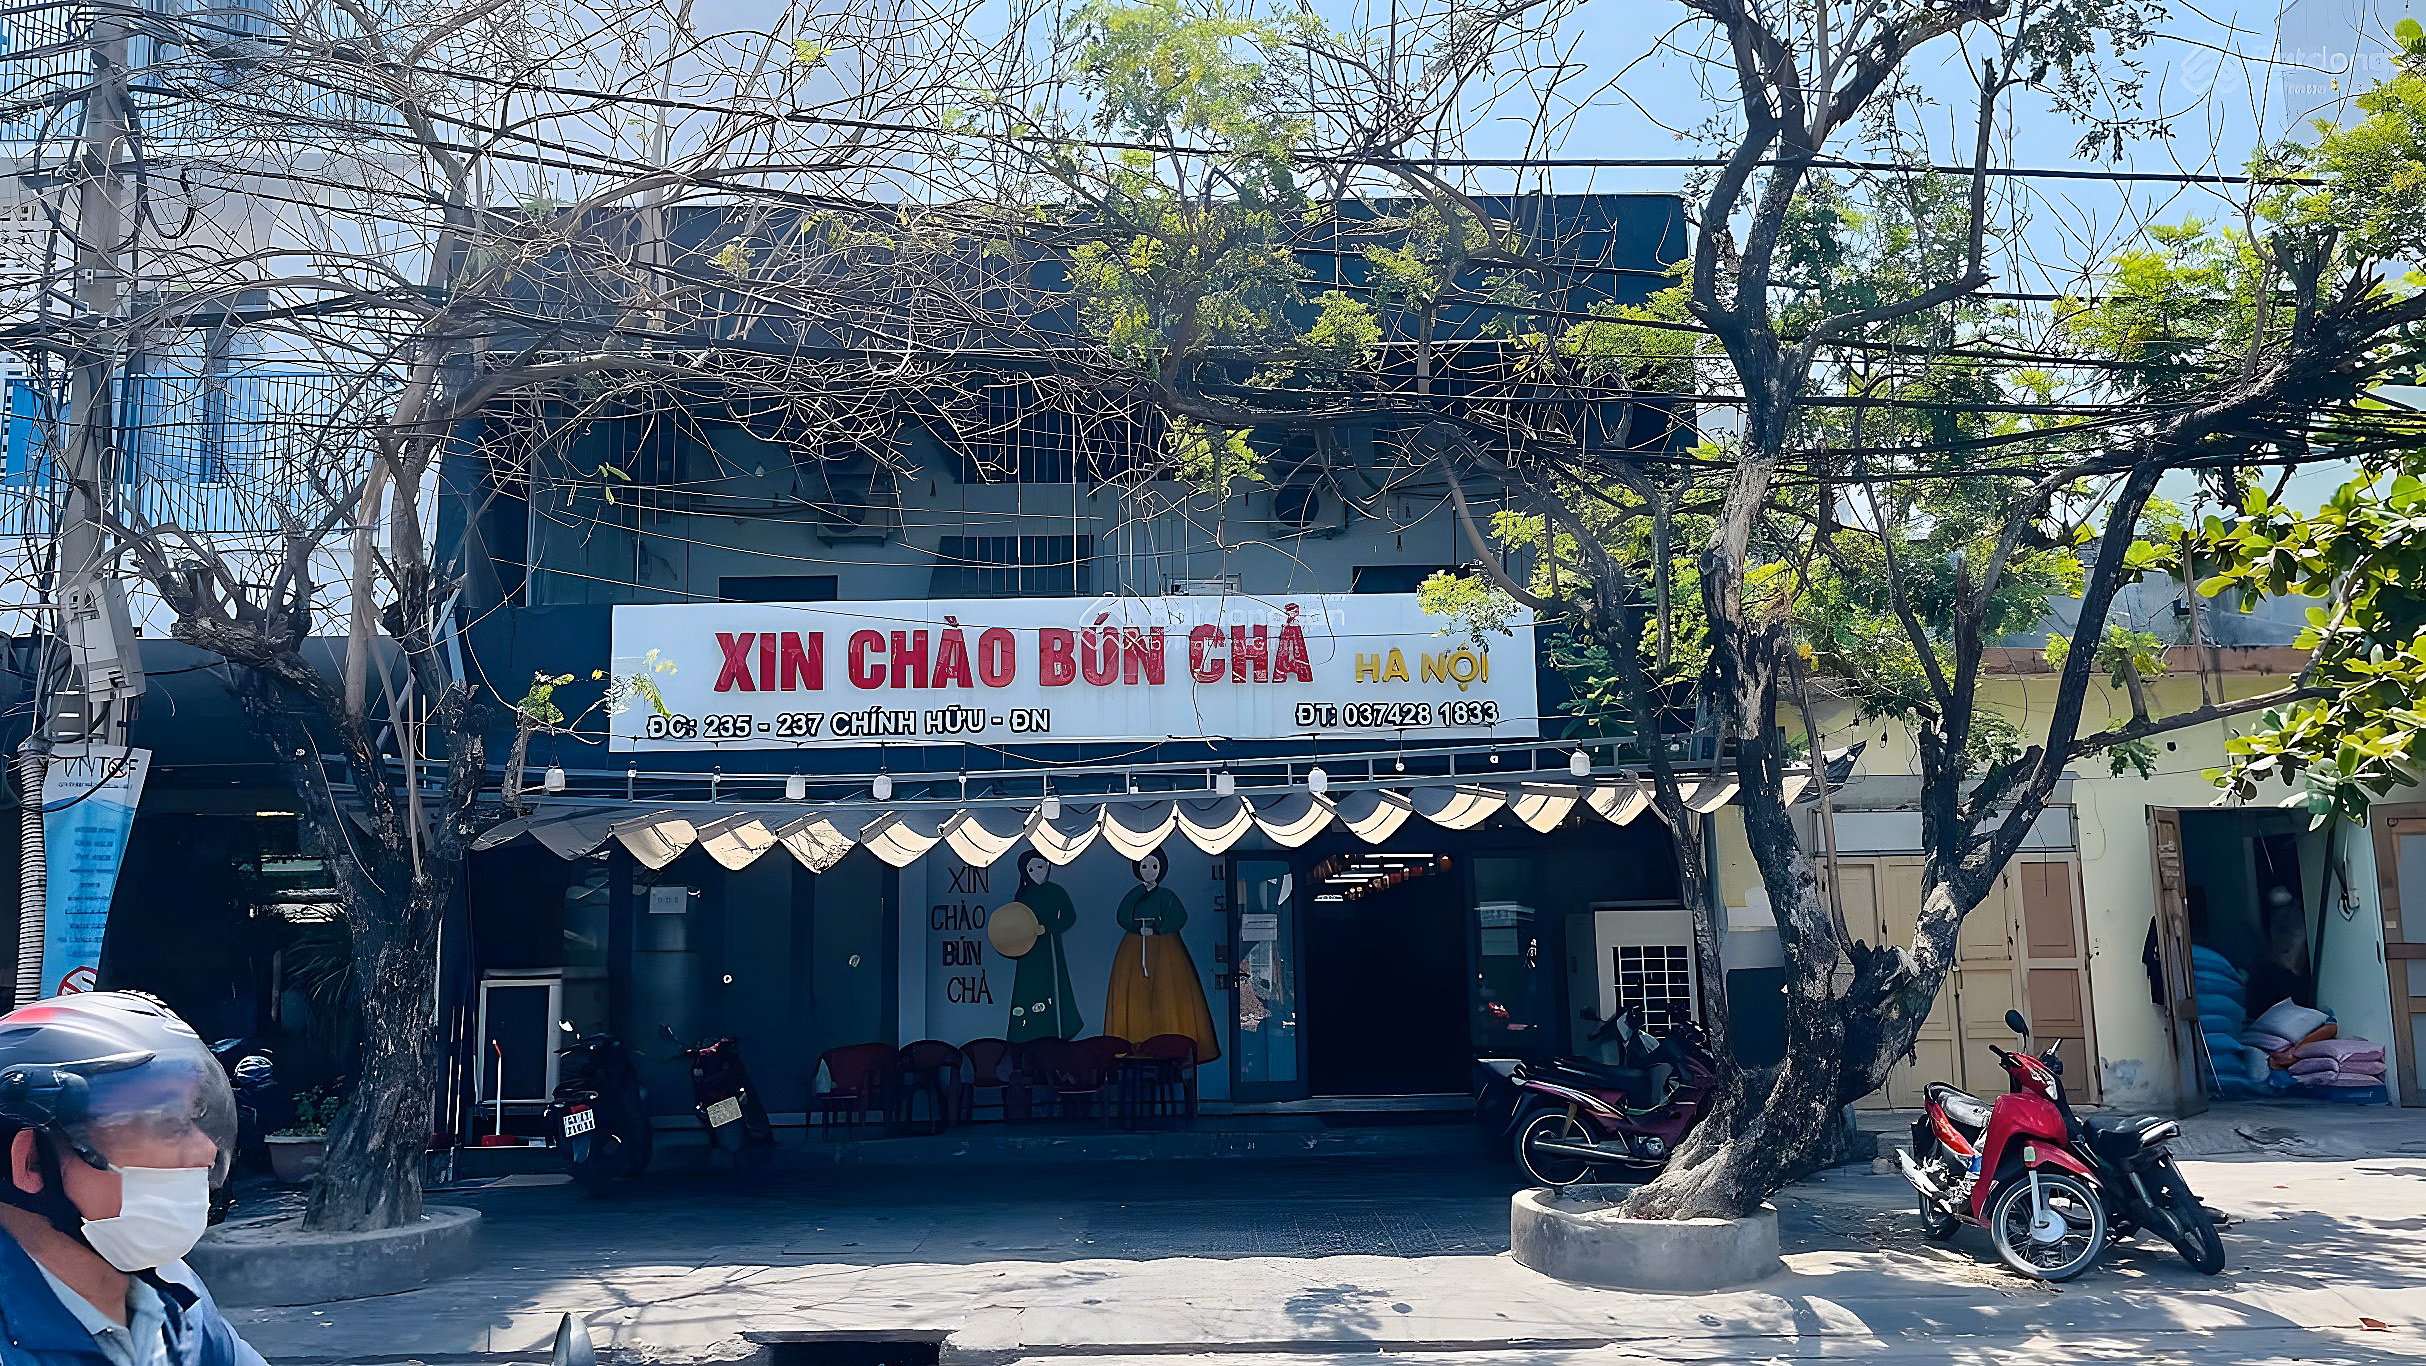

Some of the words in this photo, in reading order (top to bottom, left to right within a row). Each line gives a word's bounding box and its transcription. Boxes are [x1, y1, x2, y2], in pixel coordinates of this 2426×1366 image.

[713, 631, 825, 692] XIN
[847, 615, 1016, 690] CHÀO
[1039, 611, 1166, 687] BÚN
[1188, 602, 1314, 684] CHẢ
[646, 713, 698, 739] ĐC:
[703, 714, 752, 738] 235
[757, 722, 771, 733] -
[776, 712, 825, 737] 237
[830, 706, 917, 736] CHÍNH
[924, 704, 986, 734] HỮU
[990, 716, 1004, 726] -
[1009, 708, 1050, 733] ĐN
[1295, 701, 1338, 727] ĐT:
[1343, 702, 1432, 727] 037428
[1438, 700, 1500, 728] 1833
[947, 865, 990, 894] XIN
[931, 899, 987, 931] CHÀO
[942, 935, 982, 967] BÚN
